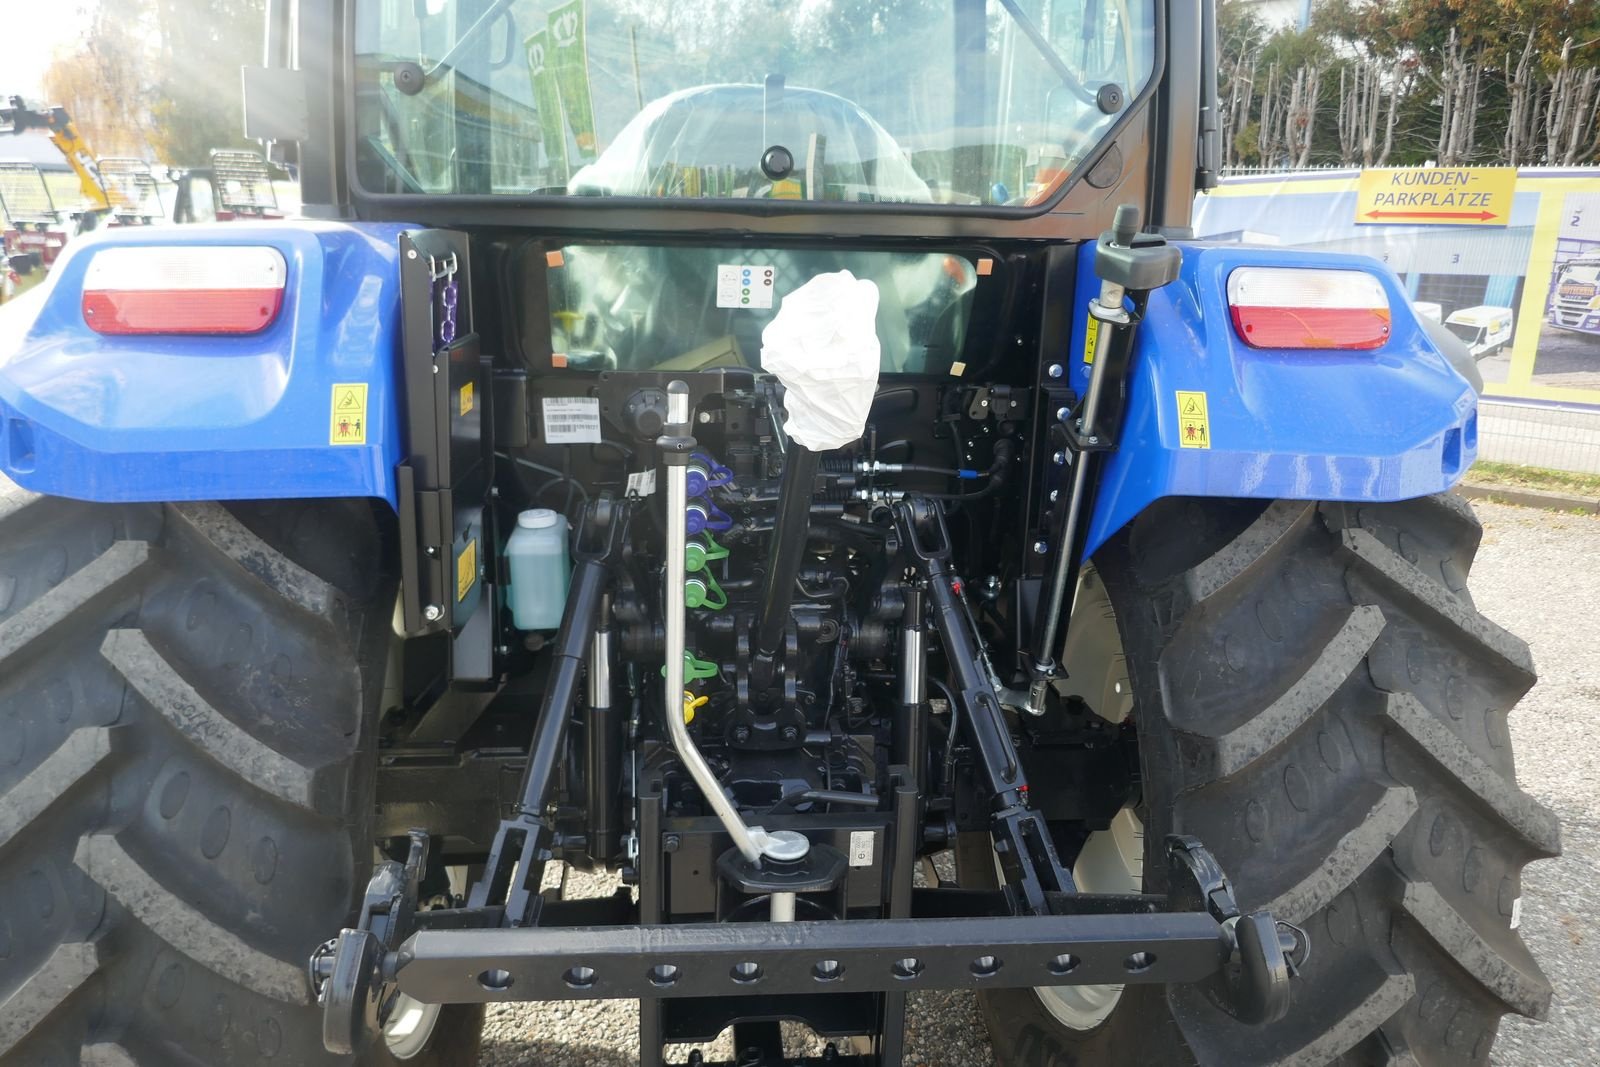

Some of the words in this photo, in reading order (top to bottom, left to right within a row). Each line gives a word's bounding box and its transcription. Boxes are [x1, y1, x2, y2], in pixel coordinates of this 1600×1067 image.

[1391, 171, 1479, 185] KUNDEN-
[1374, 187, 1492, 206] PARKPLÄTZE
[1570, 215, 1581, 227] 2
[1451, 254, 1461, 264] 3
